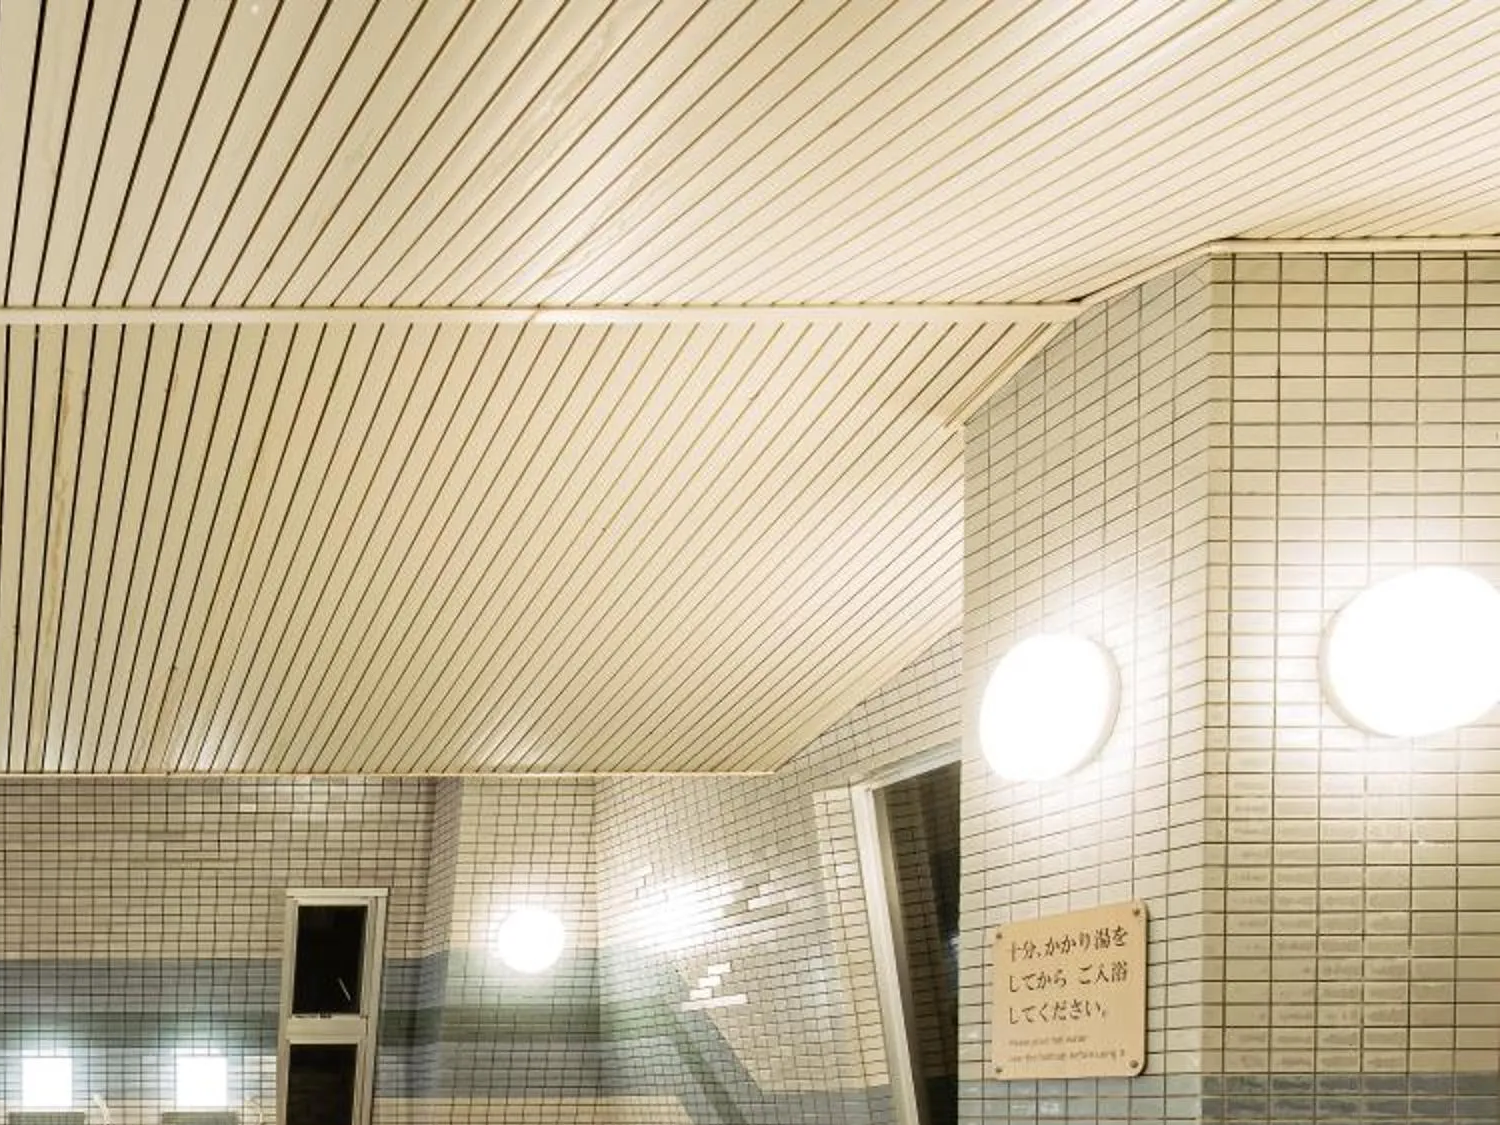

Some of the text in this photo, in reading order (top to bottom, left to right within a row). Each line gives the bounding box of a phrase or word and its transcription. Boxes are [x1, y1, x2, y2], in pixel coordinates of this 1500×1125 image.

[1009, 960, 1128, 993] してから ご入浴
[1009, 999, 1107, 1025] してください。
